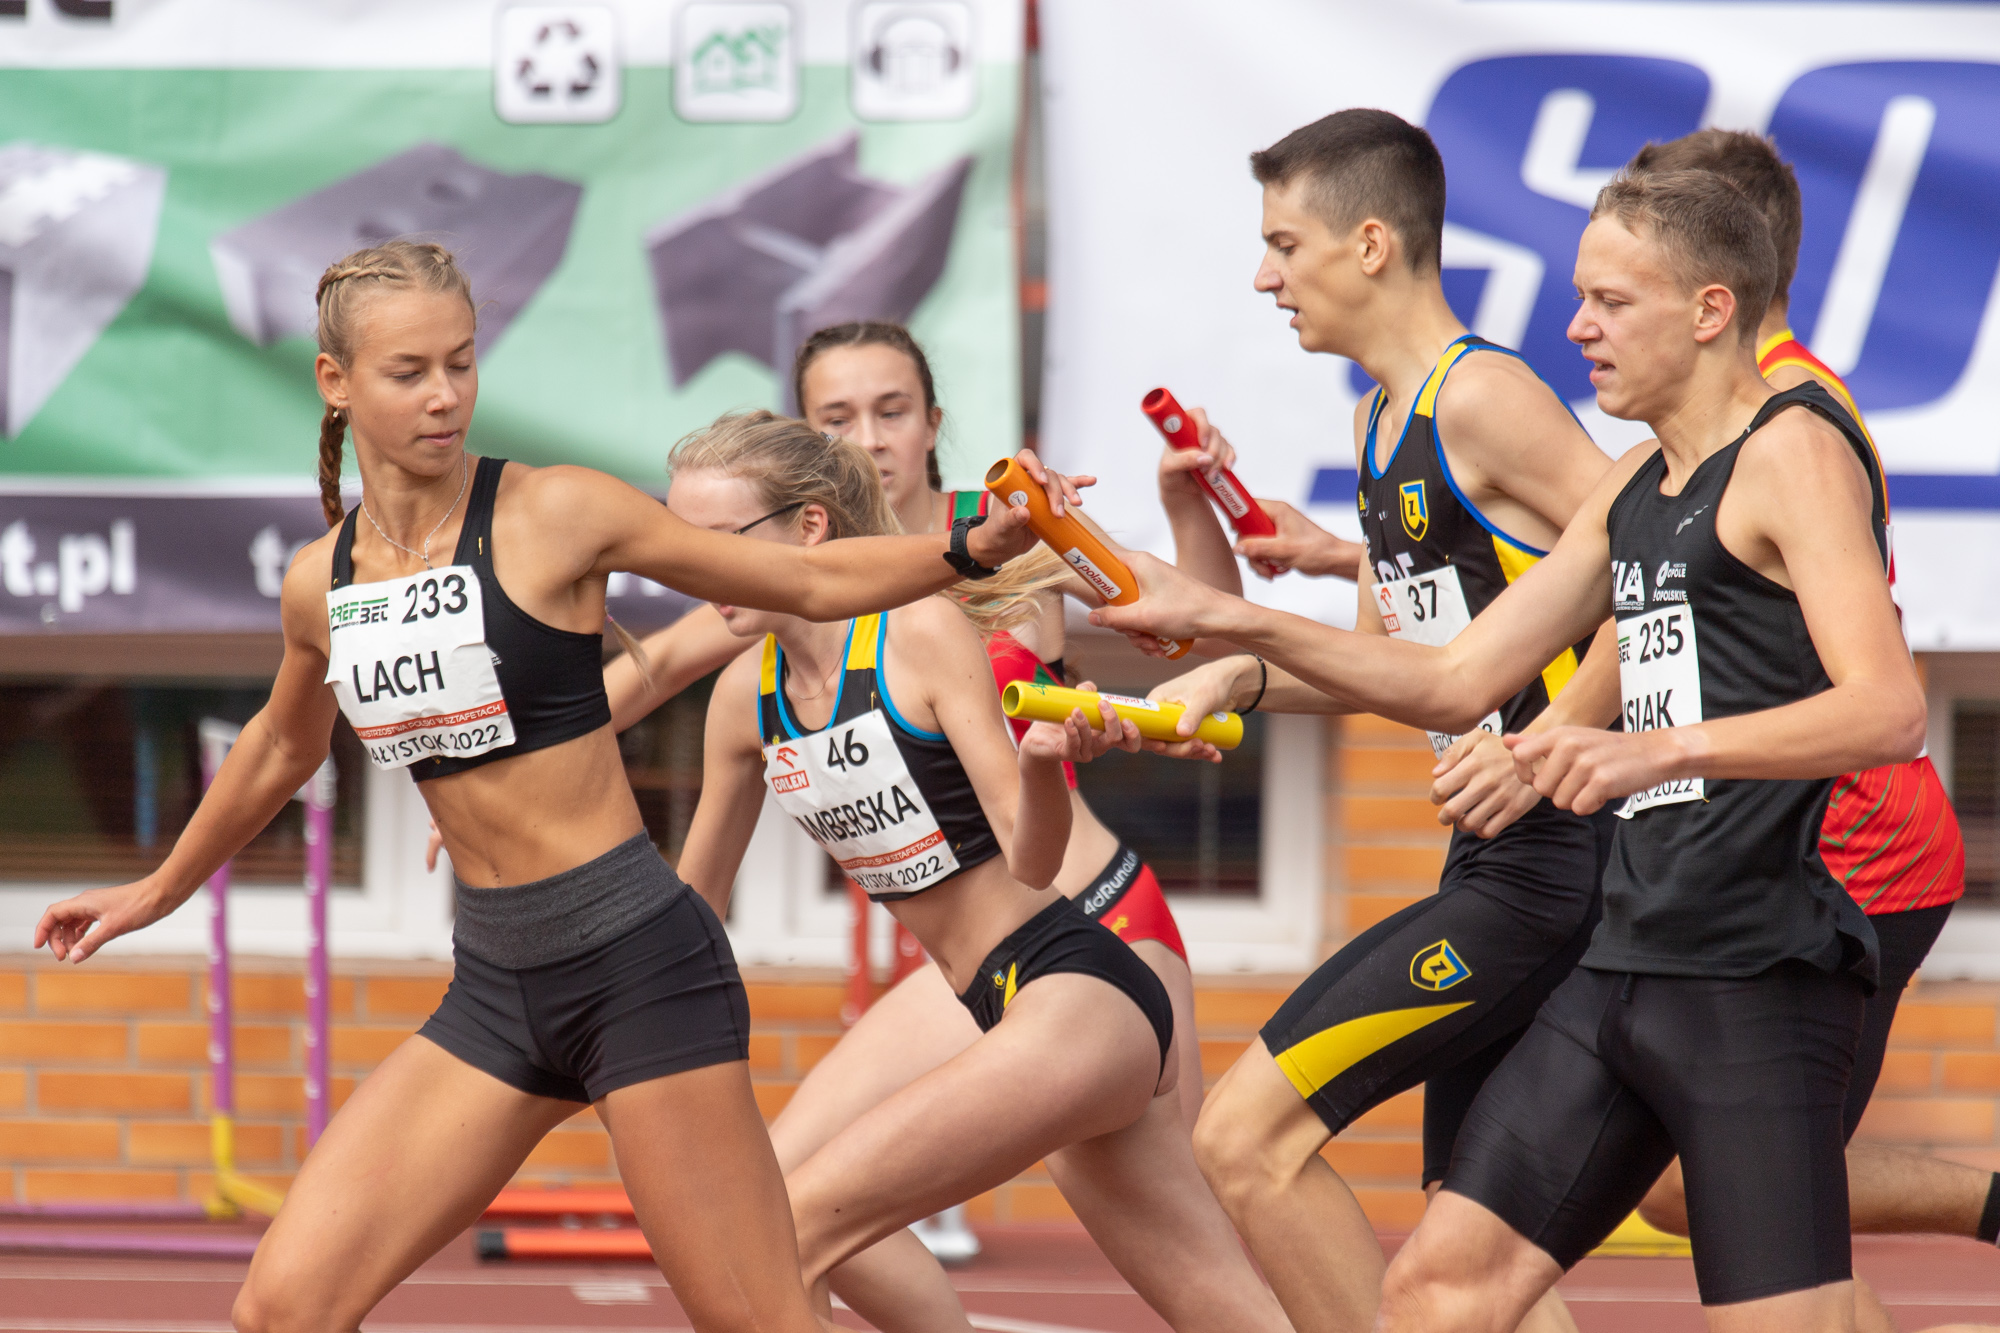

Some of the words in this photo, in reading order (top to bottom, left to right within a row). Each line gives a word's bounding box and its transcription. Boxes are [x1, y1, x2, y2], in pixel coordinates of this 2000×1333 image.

[1215, 484, 1243, 513] polanik
[1078, 564, 1115, 595] polanik
[401, 574, 468, 625] 233
[1407, 579, 1437, 622] 37
[1639, 614, 1685, 665] 235
[352, 651, 445, 704] LACH
[408, 718, 436, 729] POLSKI
[444, 704, 501, 725] SZTAFETACH
[449, 724, 502, 751] 2022
[826, 728, 869, 772] 46
[774, 772, 808, 793] ORLEN
[890, 835, 939, 862] SZTAFETACH
[897, 855, 944, 886] 2022
